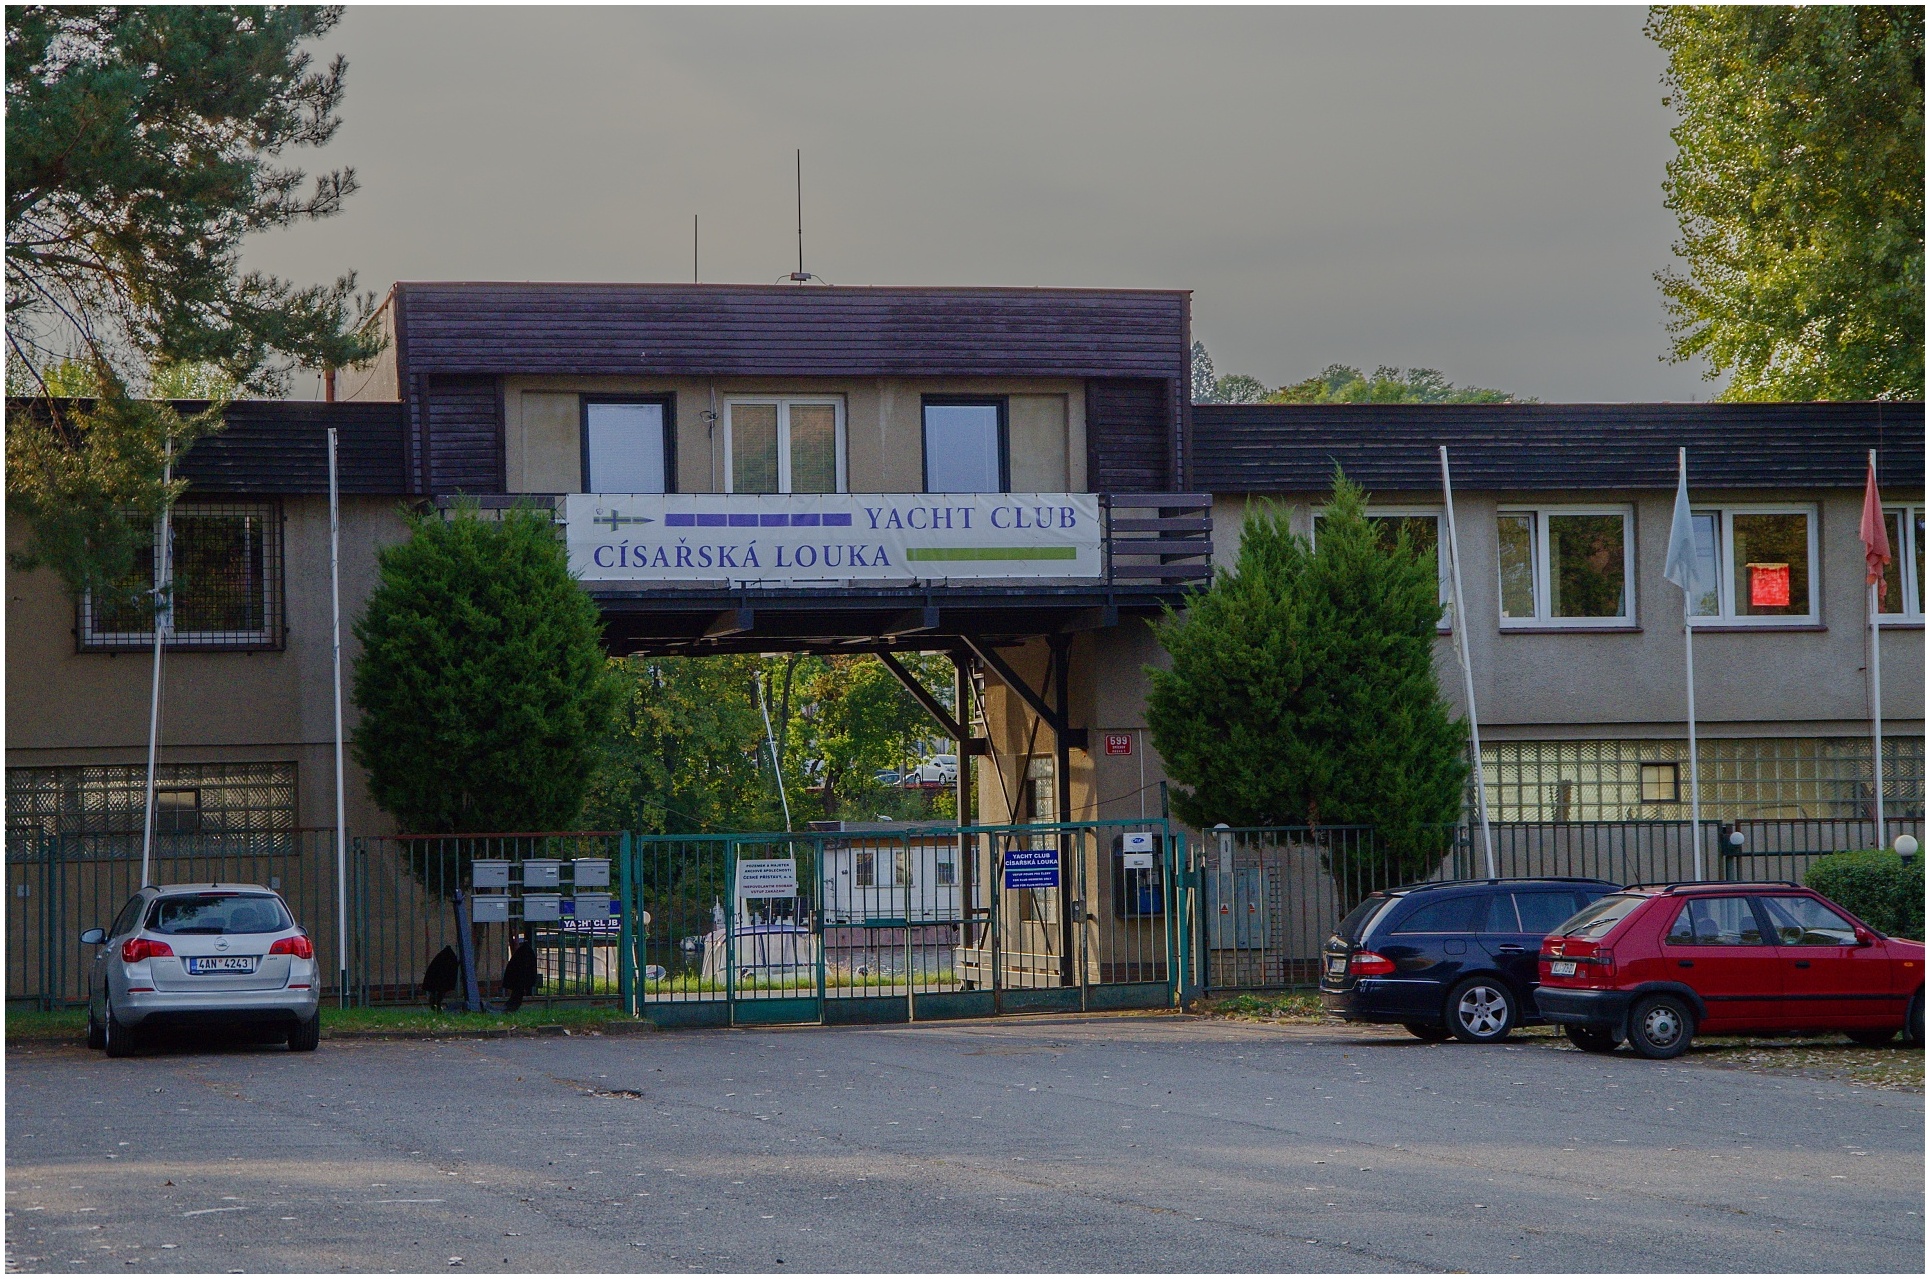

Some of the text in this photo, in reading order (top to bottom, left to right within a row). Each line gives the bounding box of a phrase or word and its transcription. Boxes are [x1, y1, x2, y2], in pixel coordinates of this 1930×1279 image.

[864, 506, 1077, 530] YACHT CLUB
[593, 537, 892, 568] CÍSAŘSKÁ LOUKA
[1110, 736, 1128, 745] 599
[199, 959, 217, 969] 4AN
[224, 958, 248, 968] 4243
